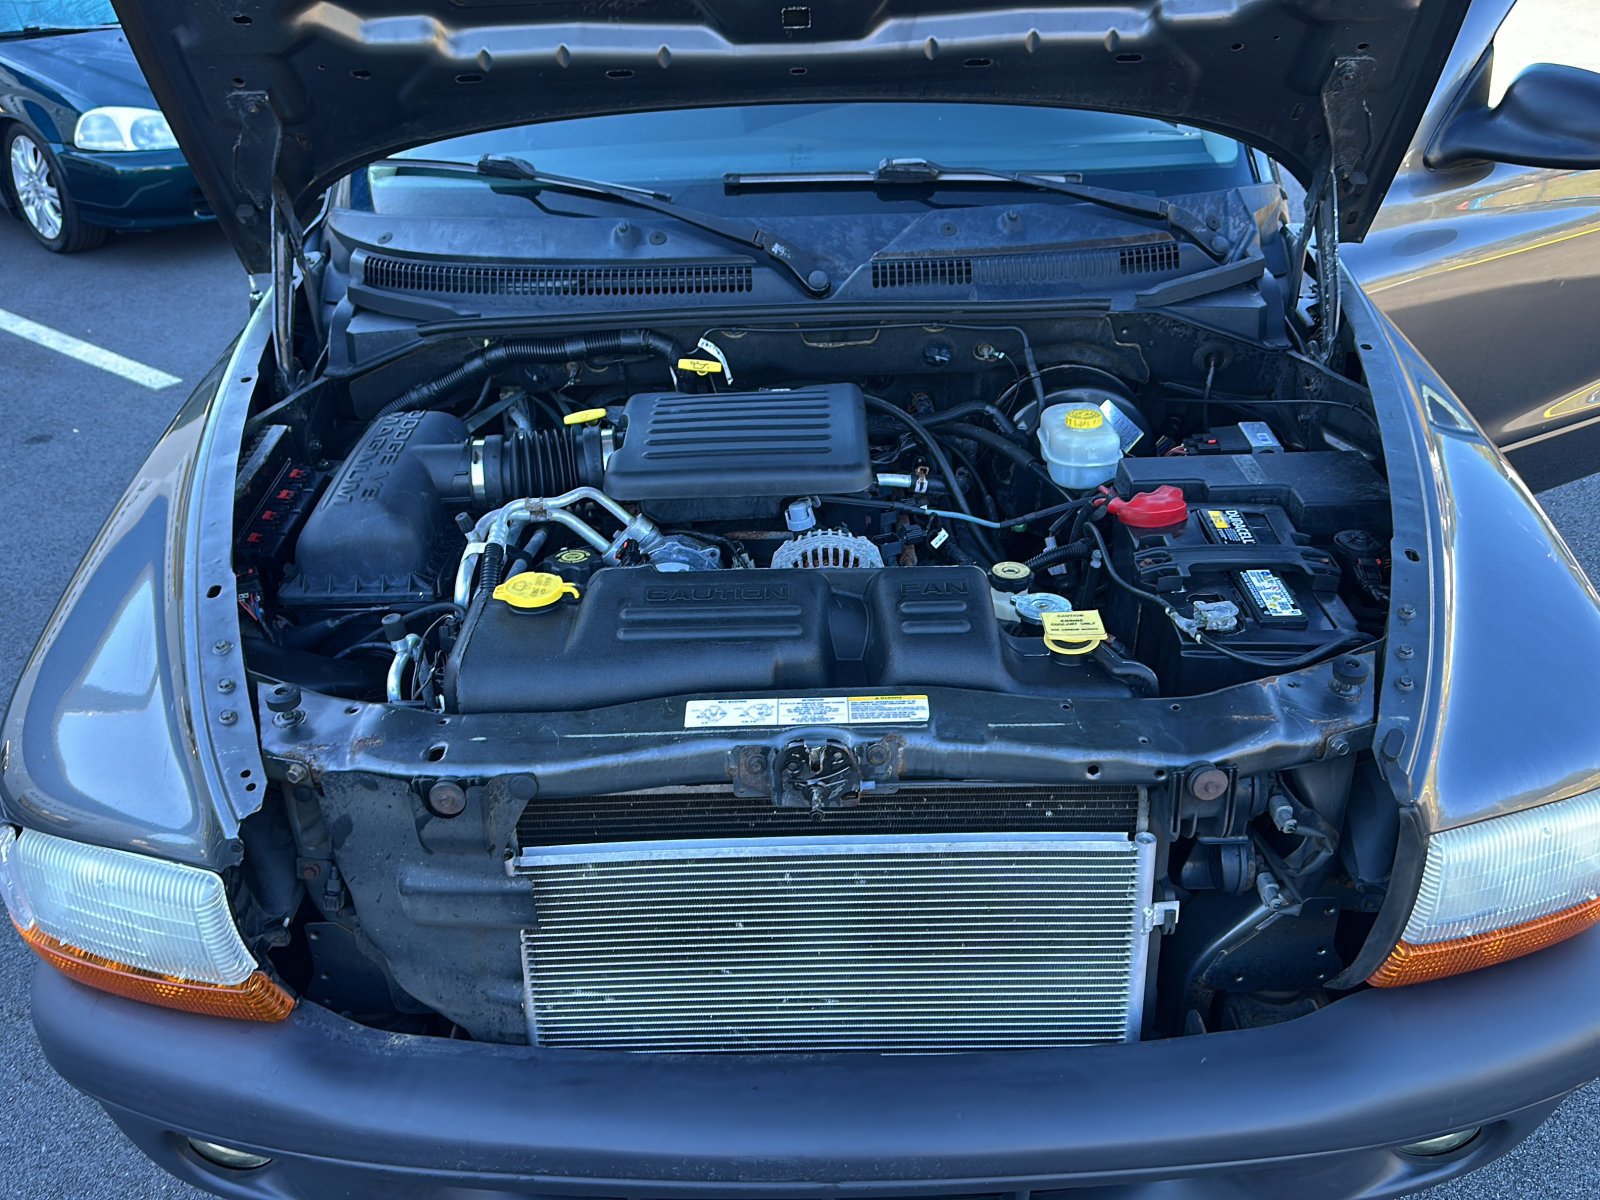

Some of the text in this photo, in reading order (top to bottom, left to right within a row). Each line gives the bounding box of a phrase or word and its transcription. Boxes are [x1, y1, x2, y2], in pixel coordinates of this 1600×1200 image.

[380, 410, 427, 465] DODGE
[333, 412, 406, 506] MAGNUM
[1225, 510, 1256, 544] DURACELL
[645, 583, 789, 601] CAUTION
[900, 581, 969, 597] FAN
